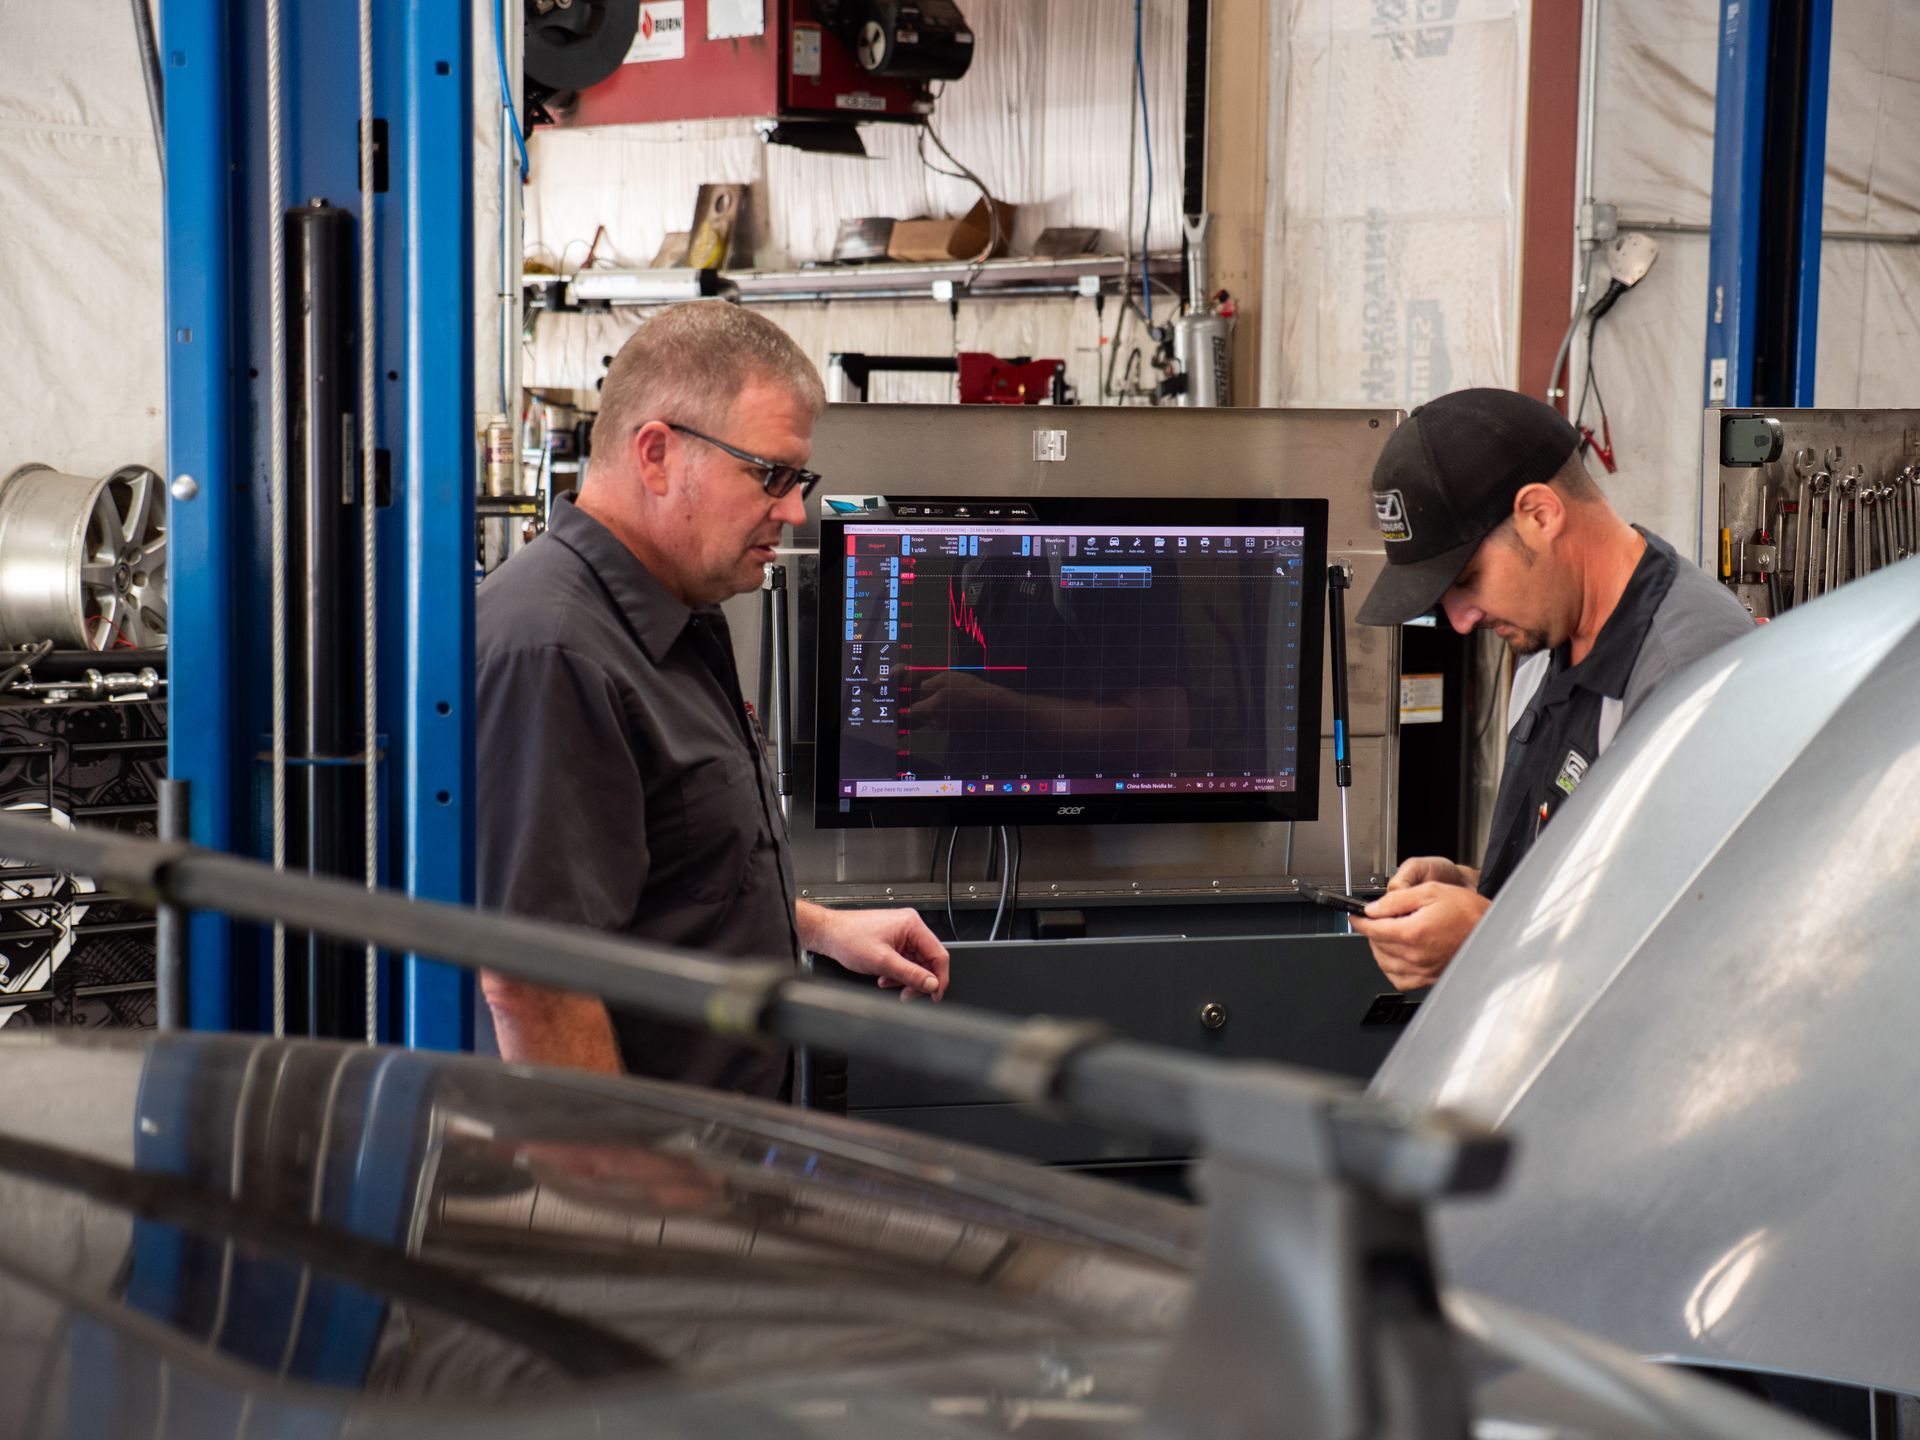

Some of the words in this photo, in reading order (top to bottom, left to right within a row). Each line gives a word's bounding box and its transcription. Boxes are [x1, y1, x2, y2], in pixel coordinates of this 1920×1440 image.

[655, 17, 682, 33] BURN
[1264, 537, 1303, 549] pico
[1057, 806, 1085, 815] acer
